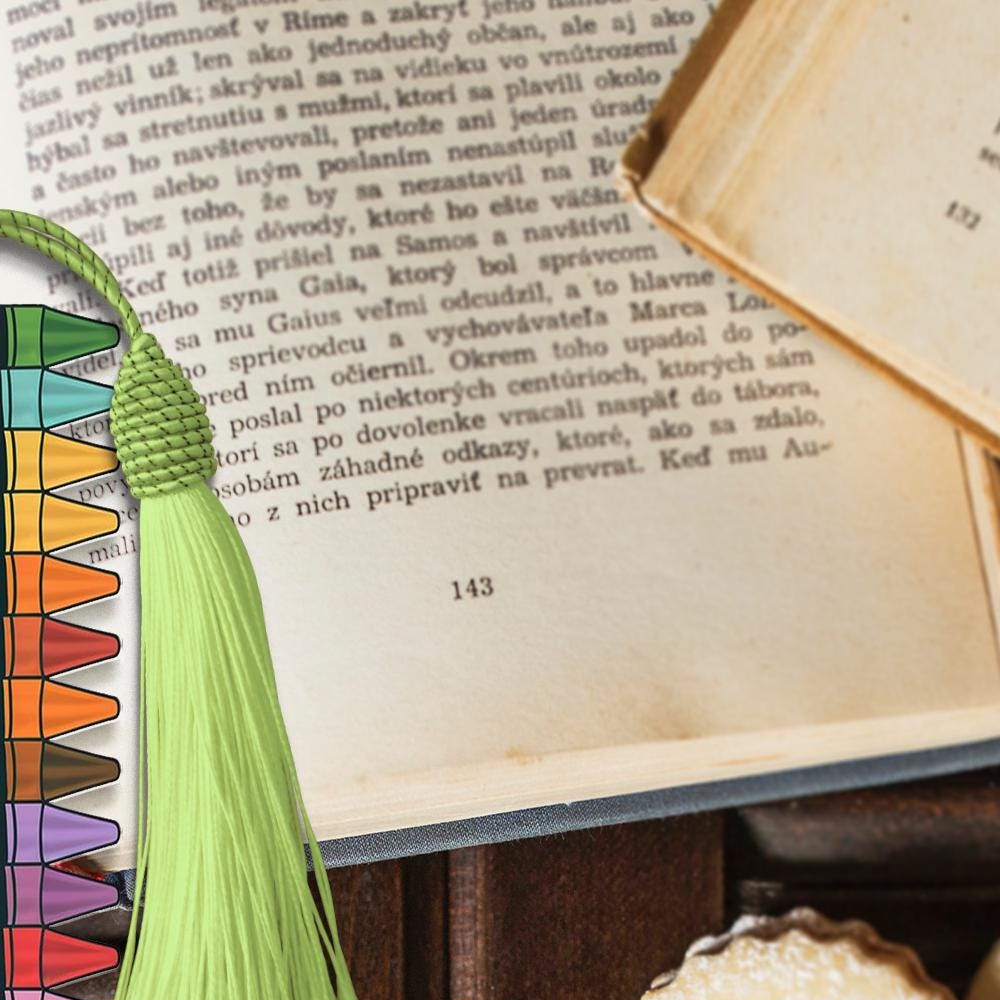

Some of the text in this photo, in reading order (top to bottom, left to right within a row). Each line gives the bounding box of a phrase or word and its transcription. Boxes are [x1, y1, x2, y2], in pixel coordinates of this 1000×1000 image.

[93, 1, 178, 32] svojím
[281, 9, 350, 33] Ríme
[387, 0, 470, 24] zakryť
[350, 114, 444, 148] pretože
[153, 172, 220, 200] alebo
[316, 145, 432, 182] poslaním
[365, 202, 435, 230] ktoré
[181, 258, 240, 287] totiž
[219, 288, 279, 314] syna
[386, 259, 457, 287] ktorý
[228, 335, 367, 375] sprievodcu
[628, 299, 708, 323] Marca
[266, 309, 342, 335] Gaius
[264, 373, 316, 397] ním
[448, 347, 538, 372] Okrem
[229, 401, 303, 440] poslal
[314, 401, 347, 426] po
[272, 440, 300, 458] sa
[311, 433, 344, 457] po
[355, 410, 487, 445] dovolenke
[318, 447, 424, 482] záhadné
[266, 506, 281, 522] z
[295, 489, 351, 517] nich
[365, 469, 483, 512] pripraviť
[451, 576, 494, 600] 143
